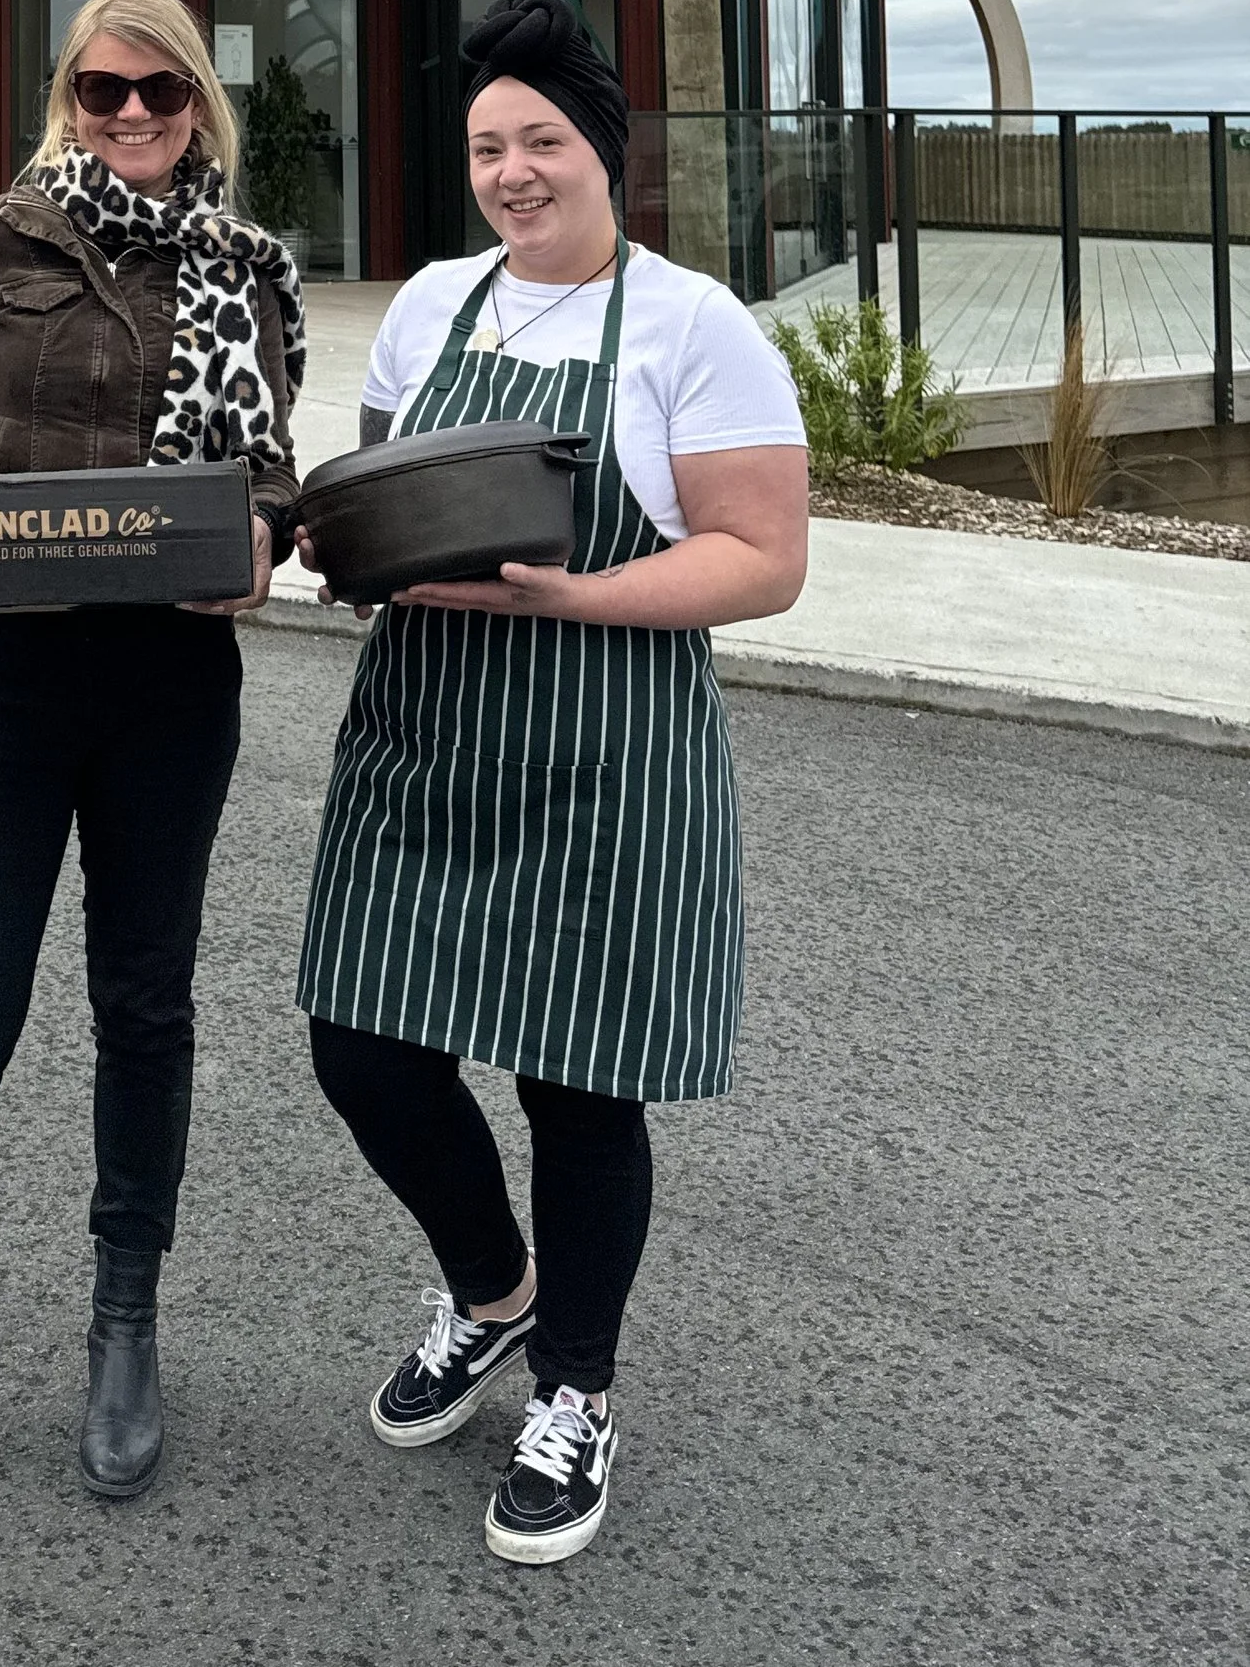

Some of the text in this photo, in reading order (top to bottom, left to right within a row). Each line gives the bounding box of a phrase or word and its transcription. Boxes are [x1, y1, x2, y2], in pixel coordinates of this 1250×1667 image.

[12, 546, 36, 560] FOR
[37, 544, 75, 559] THREE
[78, 542, 158, 558] GENERATIONS
